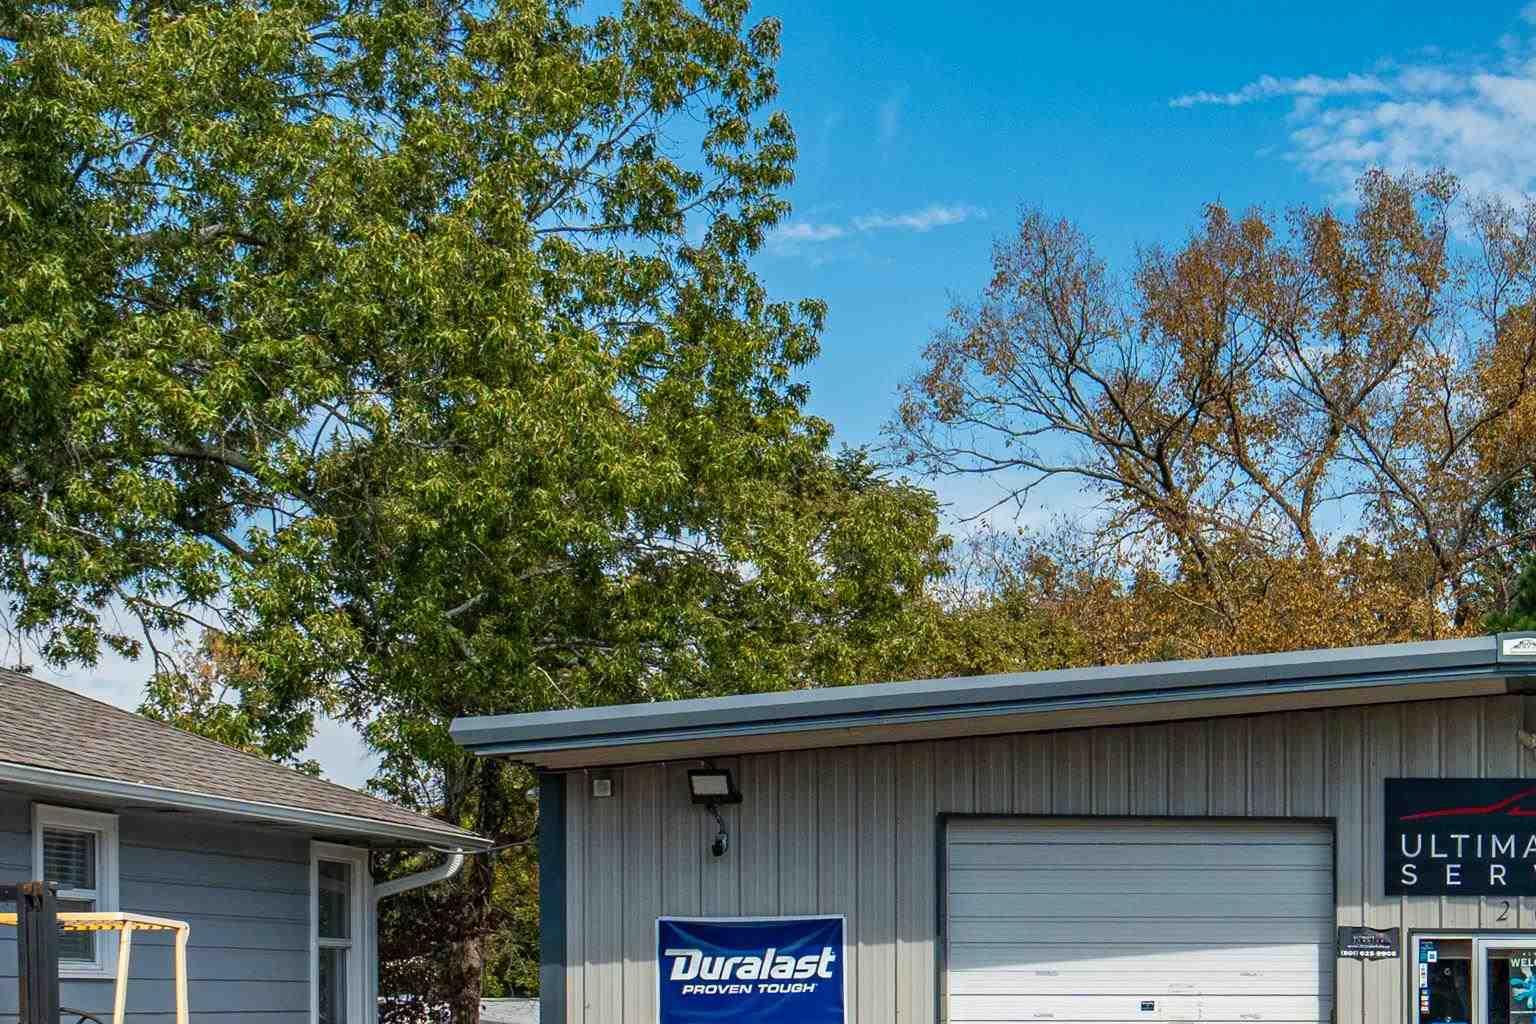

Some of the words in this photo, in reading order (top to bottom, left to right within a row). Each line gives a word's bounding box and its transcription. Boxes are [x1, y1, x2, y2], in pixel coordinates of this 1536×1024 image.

[664, 947, 836, 981] Duralast
[682, 984, 752, 995] PROVEN
[758, 983, 816, 994] TOUGH
